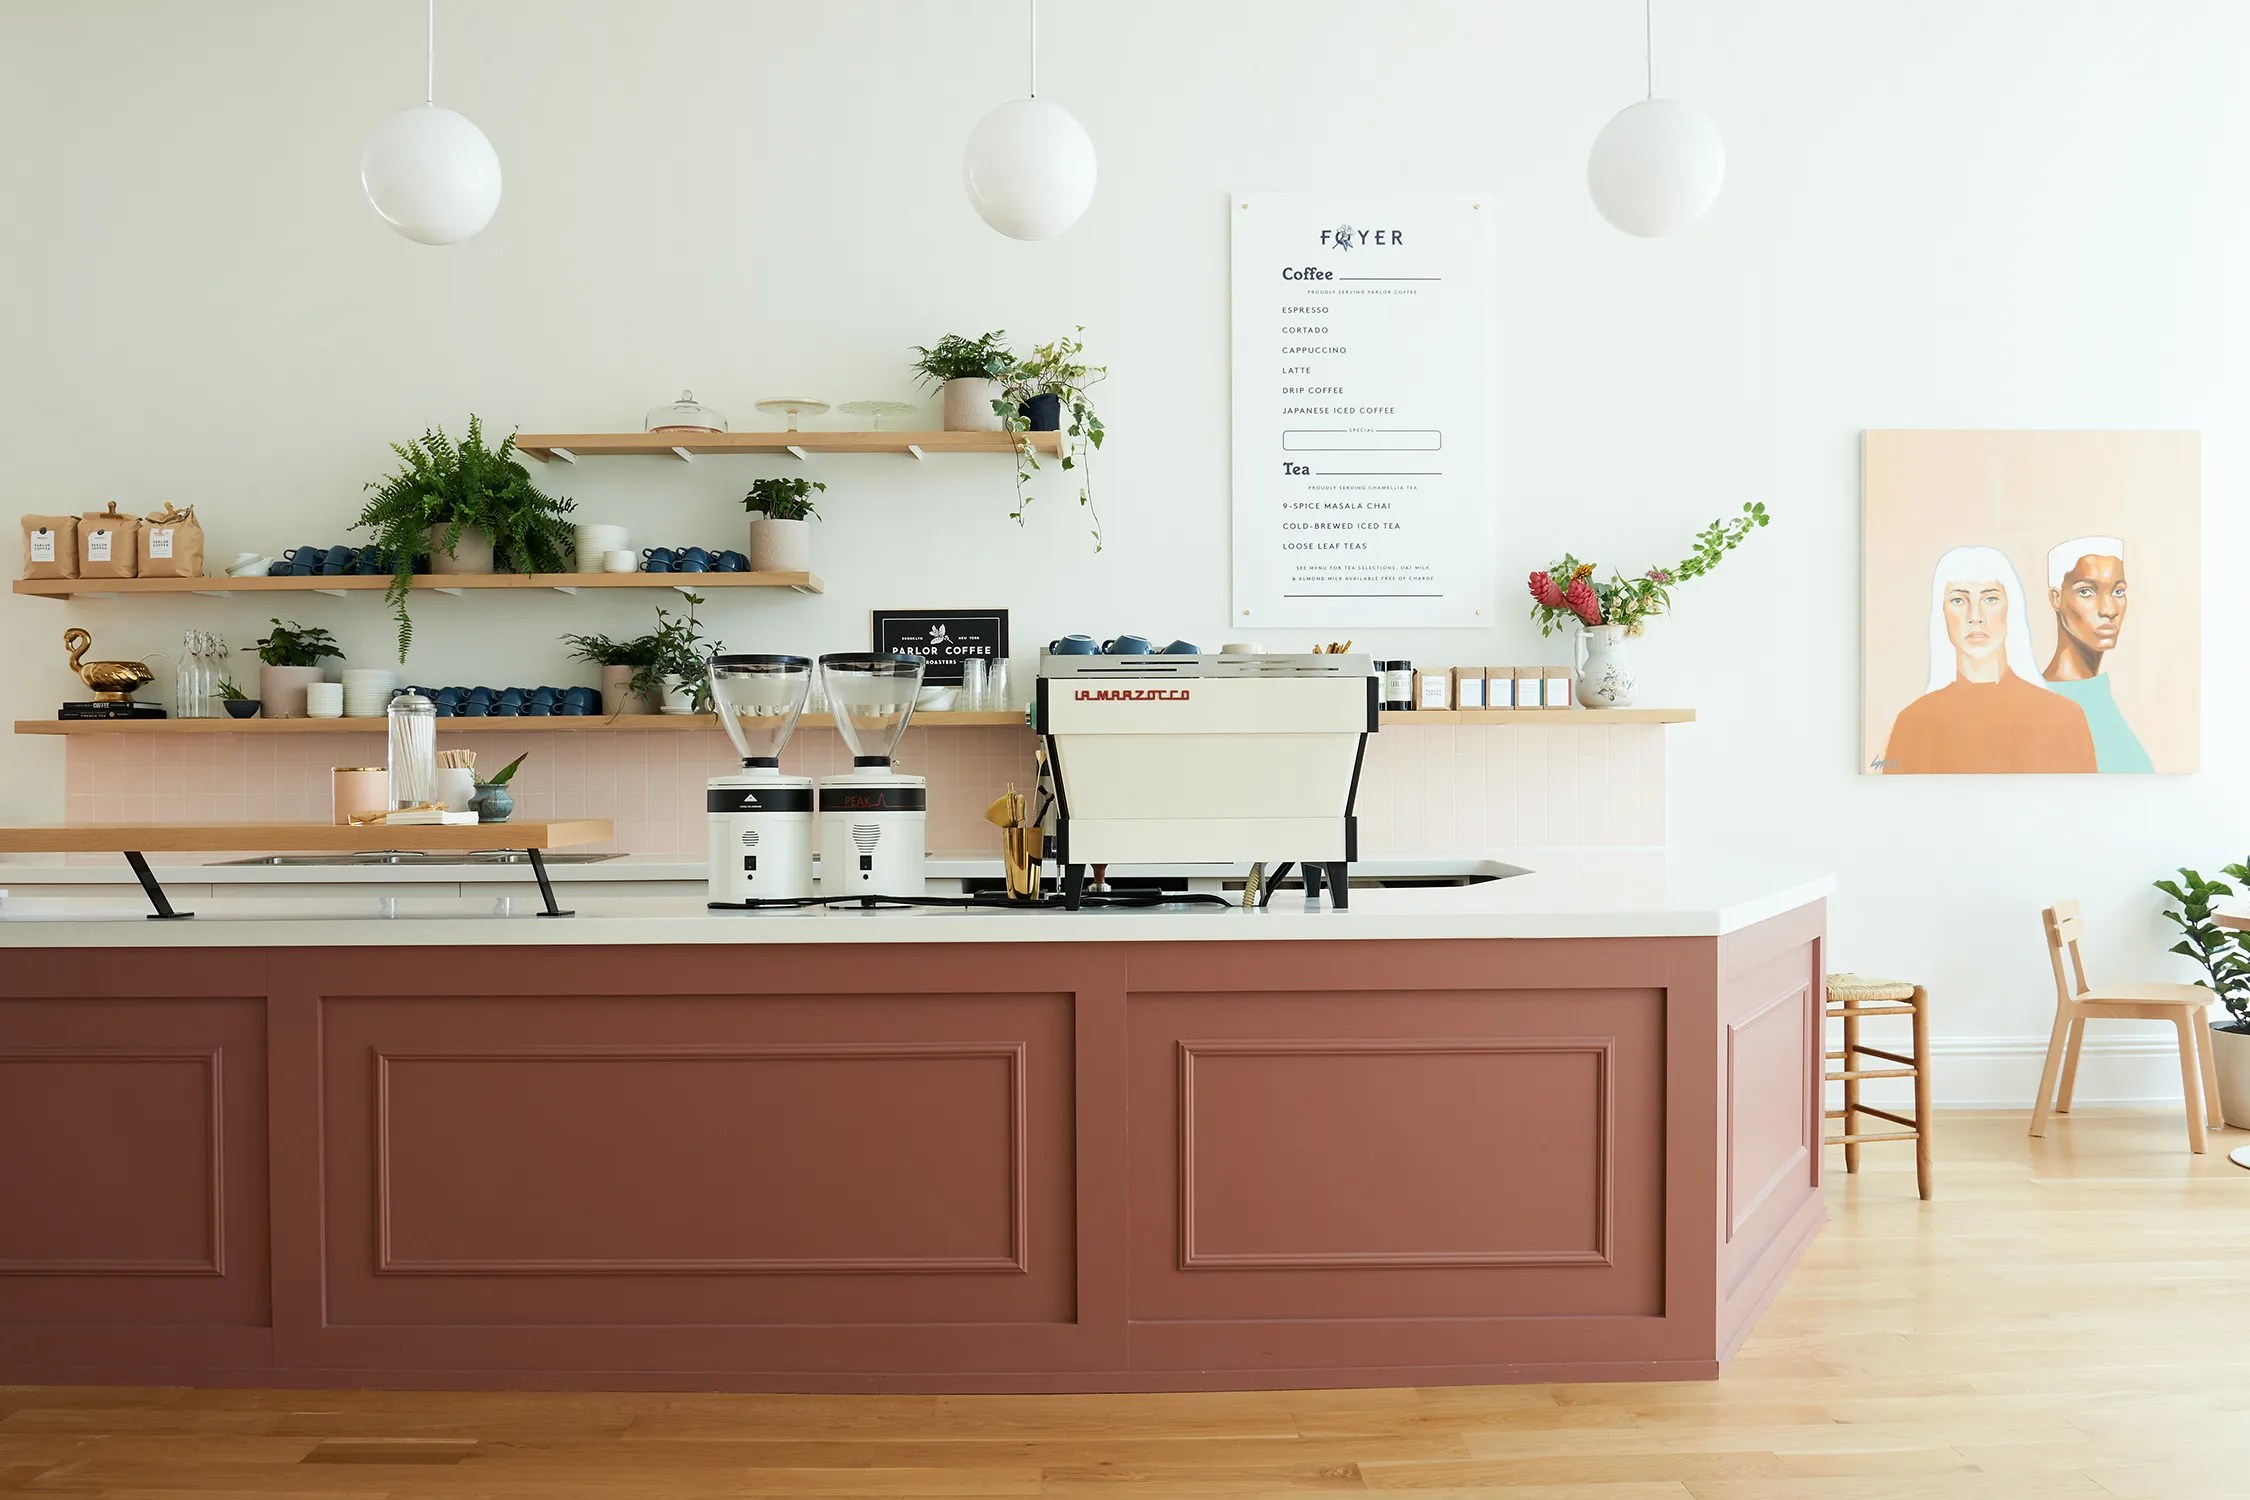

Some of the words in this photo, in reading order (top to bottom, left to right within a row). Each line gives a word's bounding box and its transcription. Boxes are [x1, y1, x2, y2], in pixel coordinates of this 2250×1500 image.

[1320, 229, 1404, 247] FOYER
[1283, 267, 1333, 280] Coffee
[1283, 462, 1310, 475] Tea
[892, 646, 938, 655] PARLOR
[945, 646, 991, 655] COFFEE
[1075, 690, 1090, 700] LA
[1097, 690, 1190, 700] MARZOCCO
[845, 796, 871, 806] PEAK
